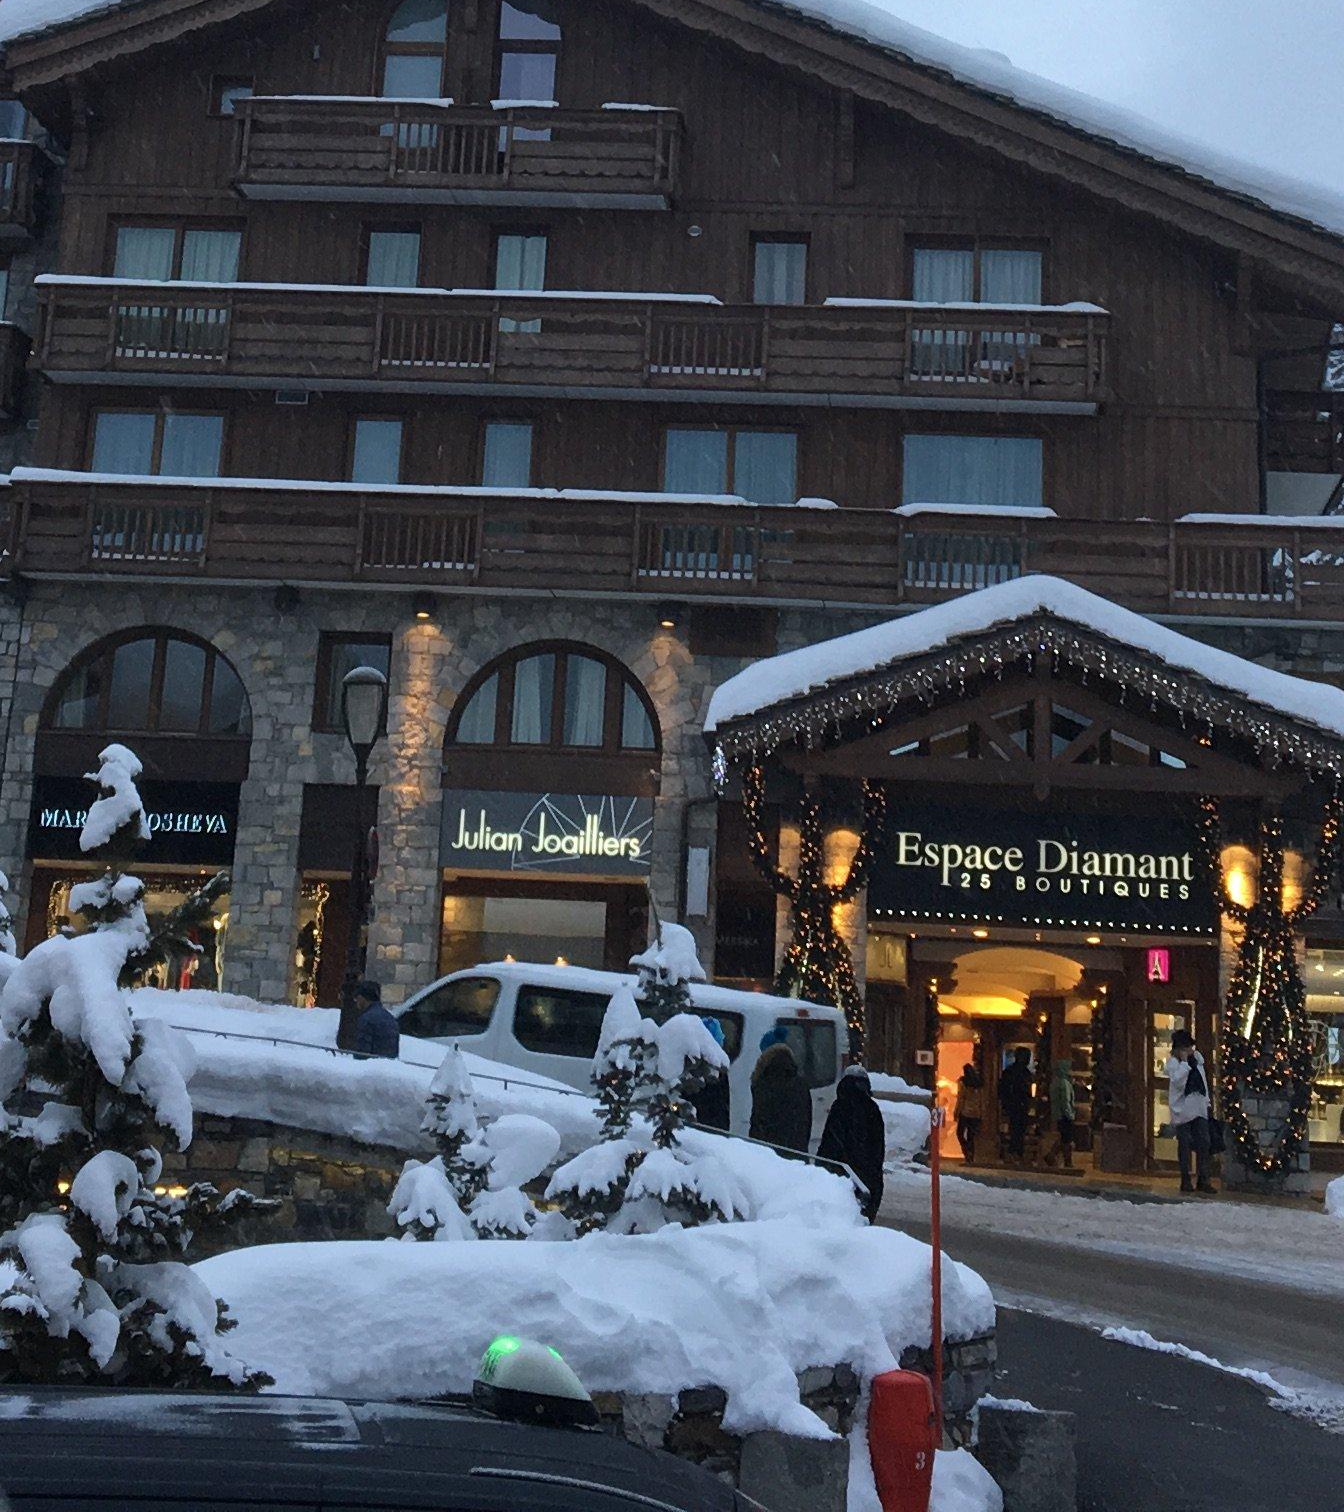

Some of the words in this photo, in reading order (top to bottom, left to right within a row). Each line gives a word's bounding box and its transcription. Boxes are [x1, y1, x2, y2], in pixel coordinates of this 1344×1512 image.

[147, 812, 227, 834] OSHEVA
[451, 808, 523, 851] Julian
[531, 811, 641, 857] Joailliers
[896, 832, 1024, 886] Espace
[1036, 840, 1194, 881] Diamant
[960, 872, 991, 889] 25
[1015, 875, 1189, 900] BOUTIQUES
